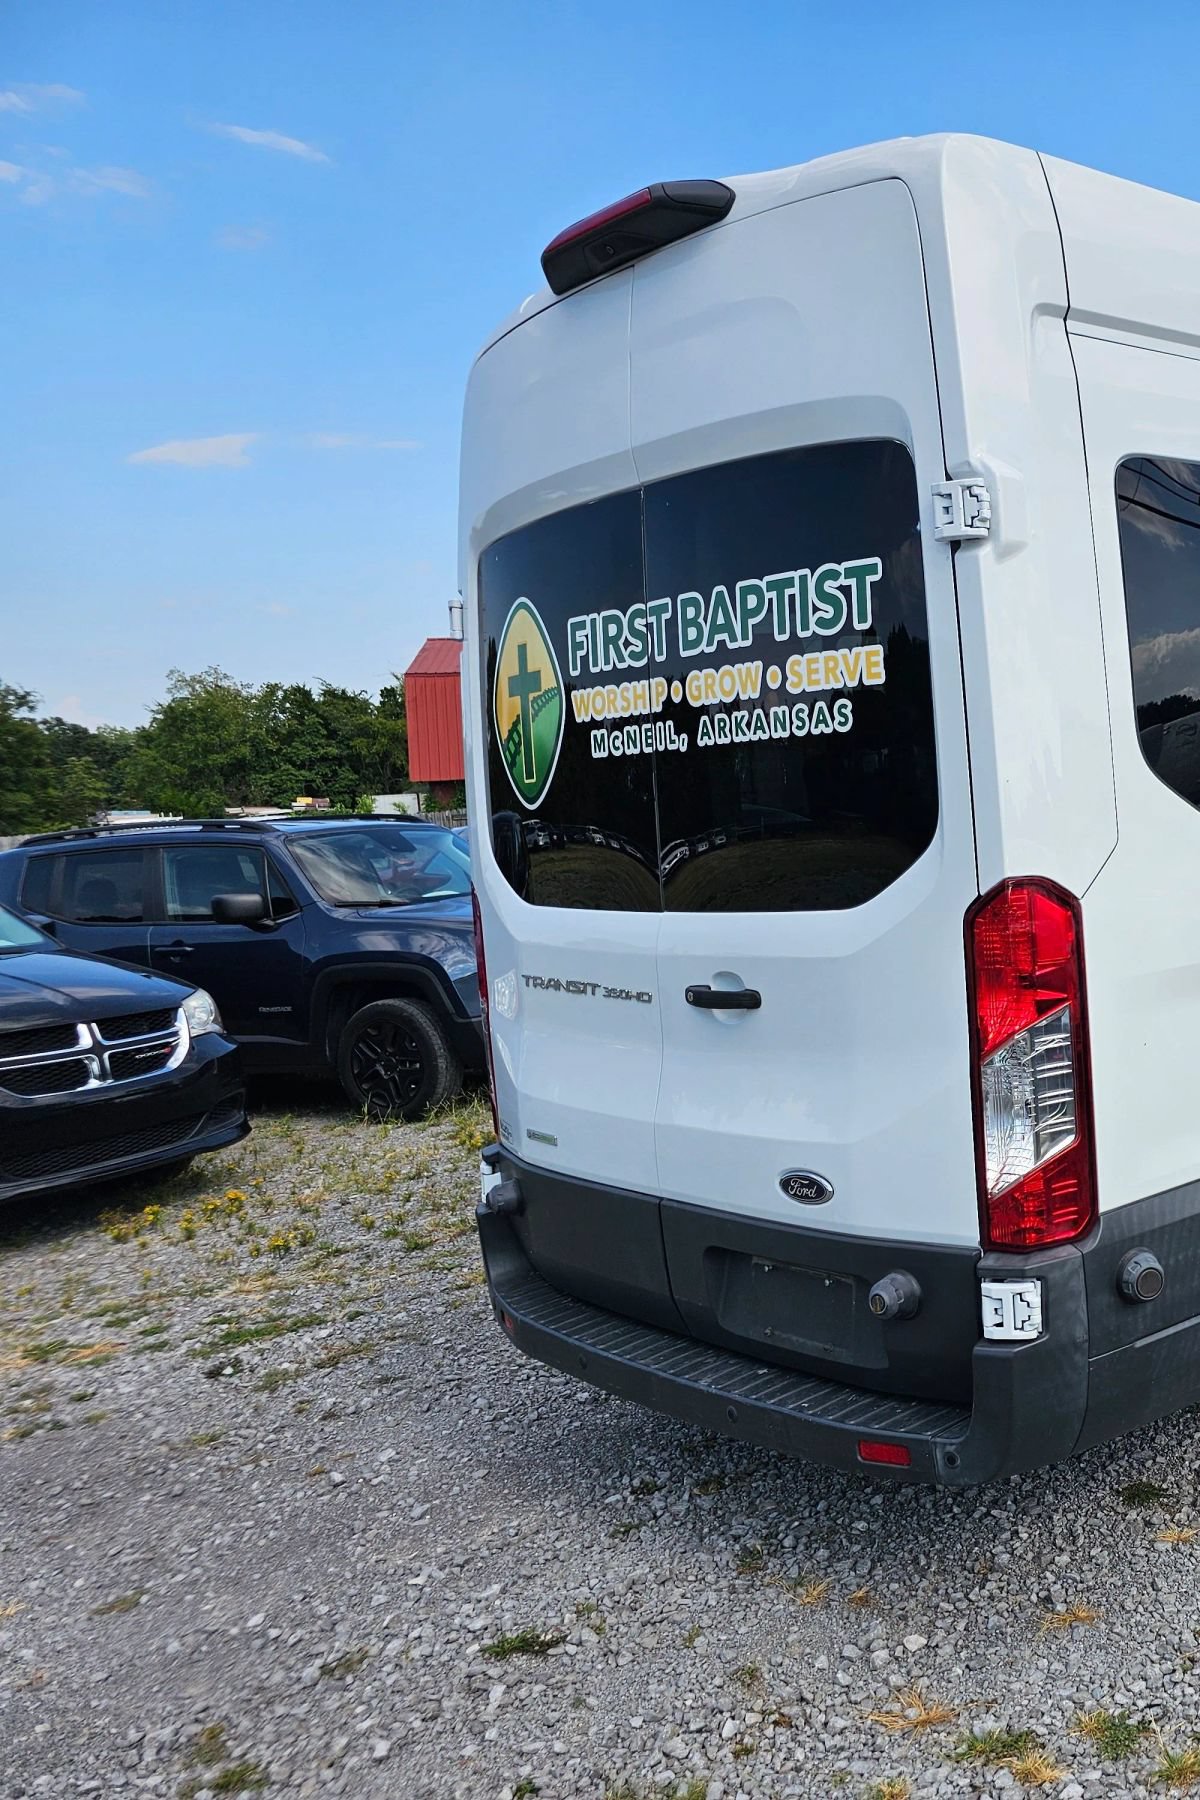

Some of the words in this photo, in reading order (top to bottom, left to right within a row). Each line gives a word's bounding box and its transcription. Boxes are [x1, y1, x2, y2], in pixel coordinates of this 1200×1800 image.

[568, 598, 671, 675] FIRST
[677, 557, 882, 657] BAPTIST
[571, 678, 667, 722] WORSHIP
[686, 662, 763, 707] GROW
[785, 646, 885, 694] SERVE
[697, 698, 853, 747] ARKANSAS
[521, 974, 602, 996] TRANSIT
[788, 1177, 817, 1197] Ford
